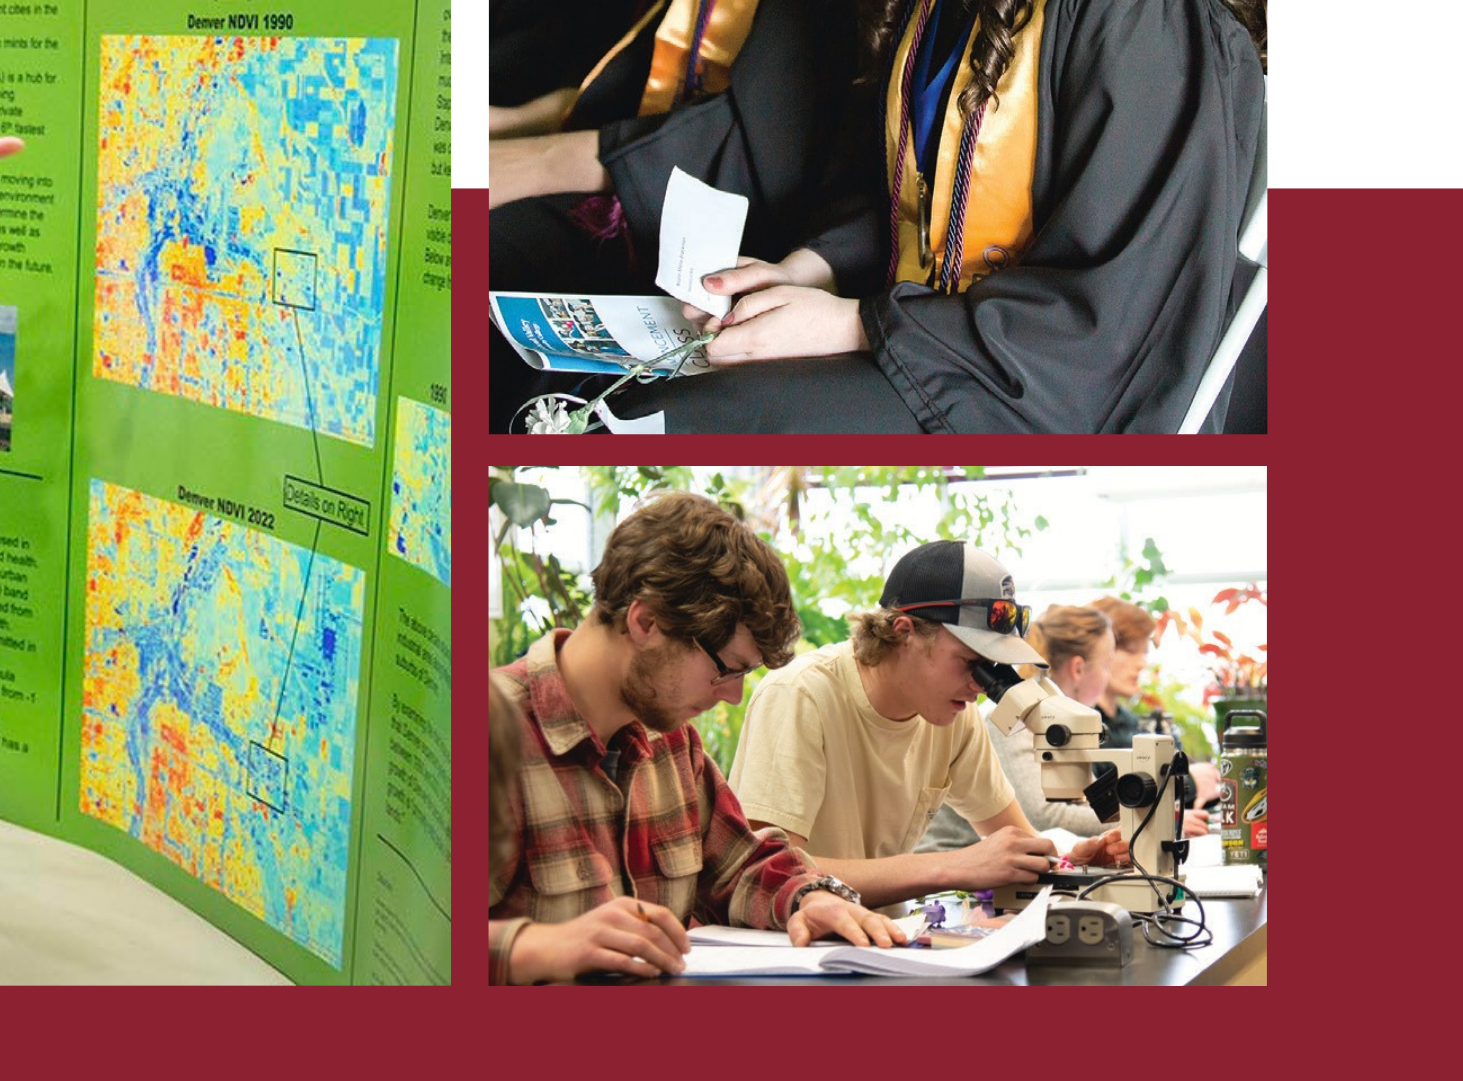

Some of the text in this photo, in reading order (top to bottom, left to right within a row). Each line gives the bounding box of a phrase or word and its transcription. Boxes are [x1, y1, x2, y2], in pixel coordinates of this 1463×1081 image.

[34, 4, 42, 14] in
[44, 4, 57, 14] the
[188, 14, 293, 29] Denver NDVI 1990
[30, 38, 42, 48] for
[44, 38, 58, 48] the
[26, 71, 42, 82] hub
[45, 72, 56, 82] for
[15, 123, 44, 134] fastest
[1, 175, 34, 188] moving
[38, 178, 53, 187] into
[29, 210, 44, 220] the
[8, 259, 22, 270] the
[25, 259, 53, 273] future.
[287, 483, 320, 510] Details
[322, 501, 334, 515] on
[178, 483, 275, 530] Denver NDVI 2022
[21, 539, 30, 549] in
[0, 569, 28, 582] urban
[4, 586, 28, 600] band
[28, 640, 36, 651] in
